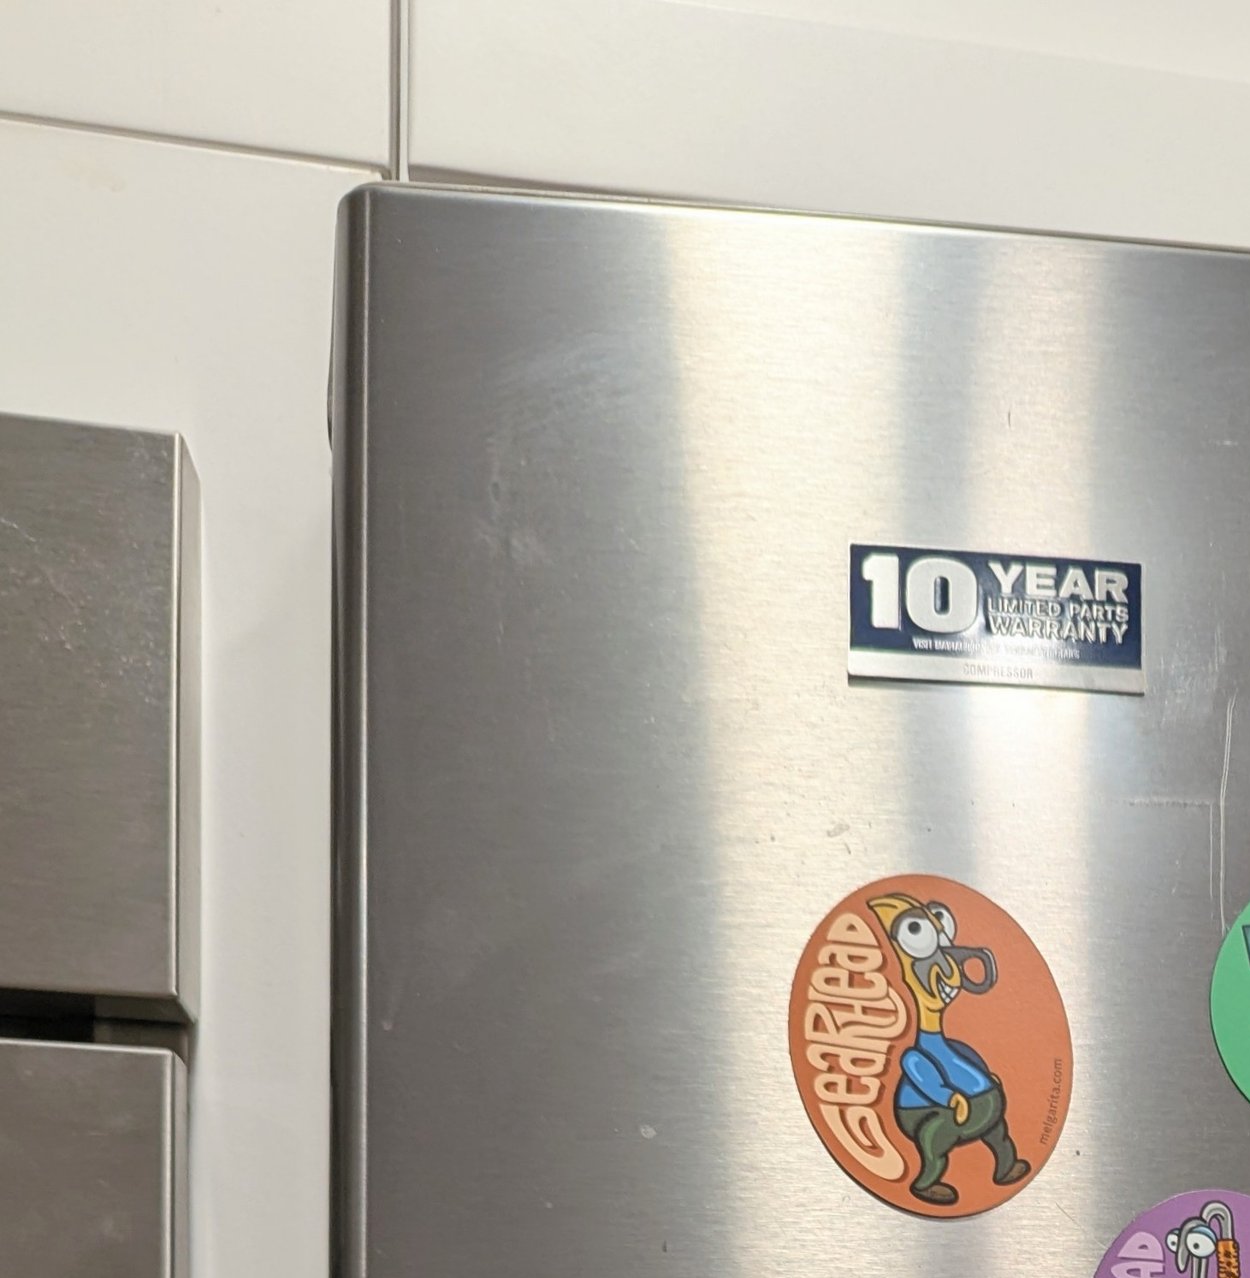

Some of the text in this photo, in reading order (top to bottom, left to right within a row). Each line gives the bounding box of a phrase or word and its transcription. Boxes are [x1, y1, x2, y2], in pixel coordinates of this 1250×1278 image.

[862, 553, 1129, 633] 10 YEAR
[987, 597, 1129, 623] LIMITED PARTS
[988, 616, 1129, 644] WARRANTY
[963, 663, 1033, 680] COMPRESSOR
[1039, 1057, 1064, 1146] melgarita.com
